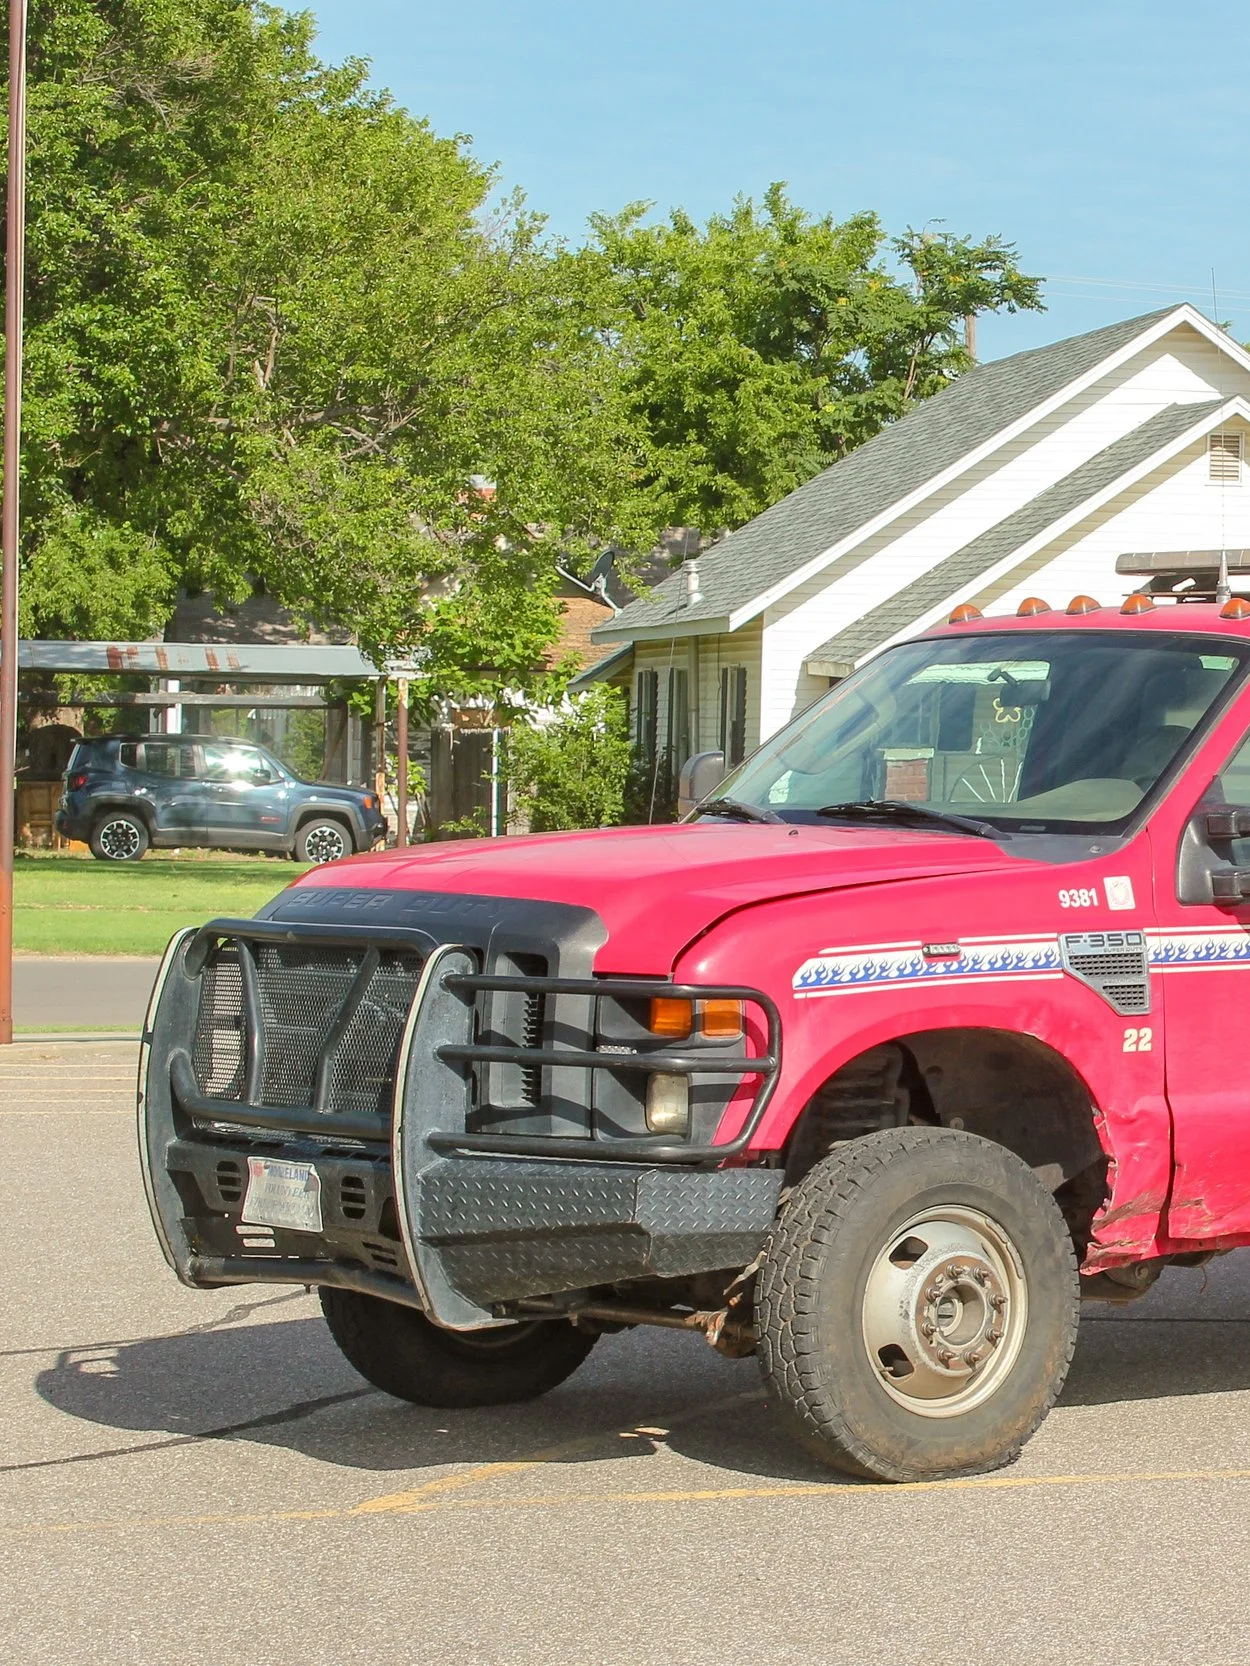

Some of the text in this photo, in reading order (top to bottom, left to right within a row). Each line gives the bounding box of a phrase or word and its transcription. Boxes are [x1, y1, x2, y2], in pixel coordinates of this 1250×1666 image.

[286, 891, 393, 910] SUPER
[1059, 888, 1099, 908] 9381
[1122, 1027, 1153, 1053] 22
